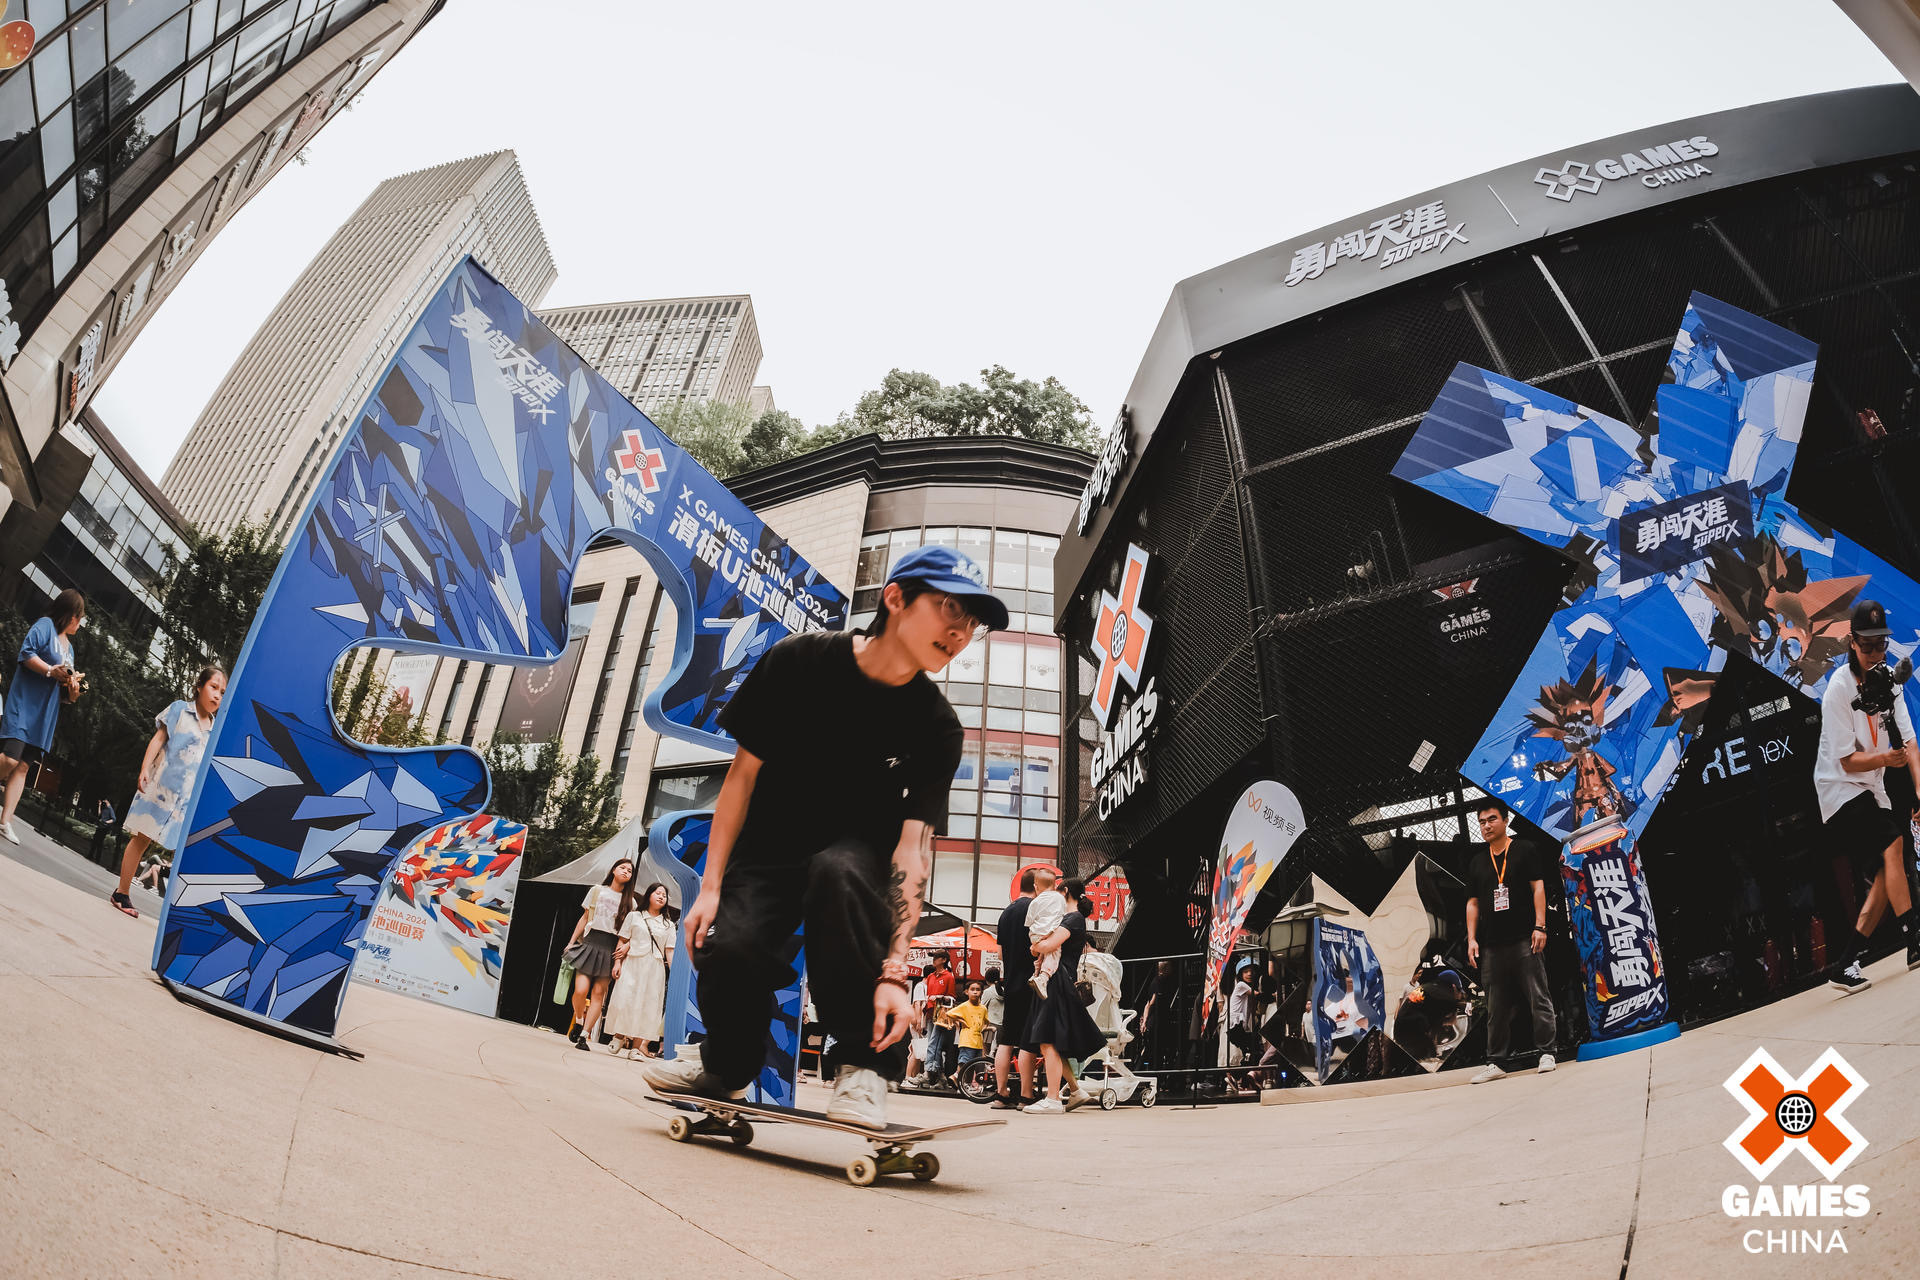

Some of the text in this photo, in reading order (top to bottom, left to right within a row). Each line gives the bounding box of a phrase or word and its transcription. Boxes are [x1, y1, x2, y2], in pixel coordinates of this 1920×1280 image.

[1595, 136, 1719, 180] GAMES
[1641, 162, 1712, 189] CHINA
[1284, 200, 1448, 287] 勇闯天涯
[605, 467, 656, 515] GAMES
[1636, 496, 1729, 553] 勇闯天涯
[678, 484, 829, 624] X GAMES CHINA 2024
[1440, 608, 1491, 633] GAMES
[1450, 626, 1488, 643] CHINA
[1091, 676, 1158, 789] GAMES
[1099, 756, 1145, 821] CHINA
[1263, 805, 1296, 837] 视频号
[377, 905, 427, 926] CHINA 2024
[1589, 857, 1652, 987] 勇闯天涯
